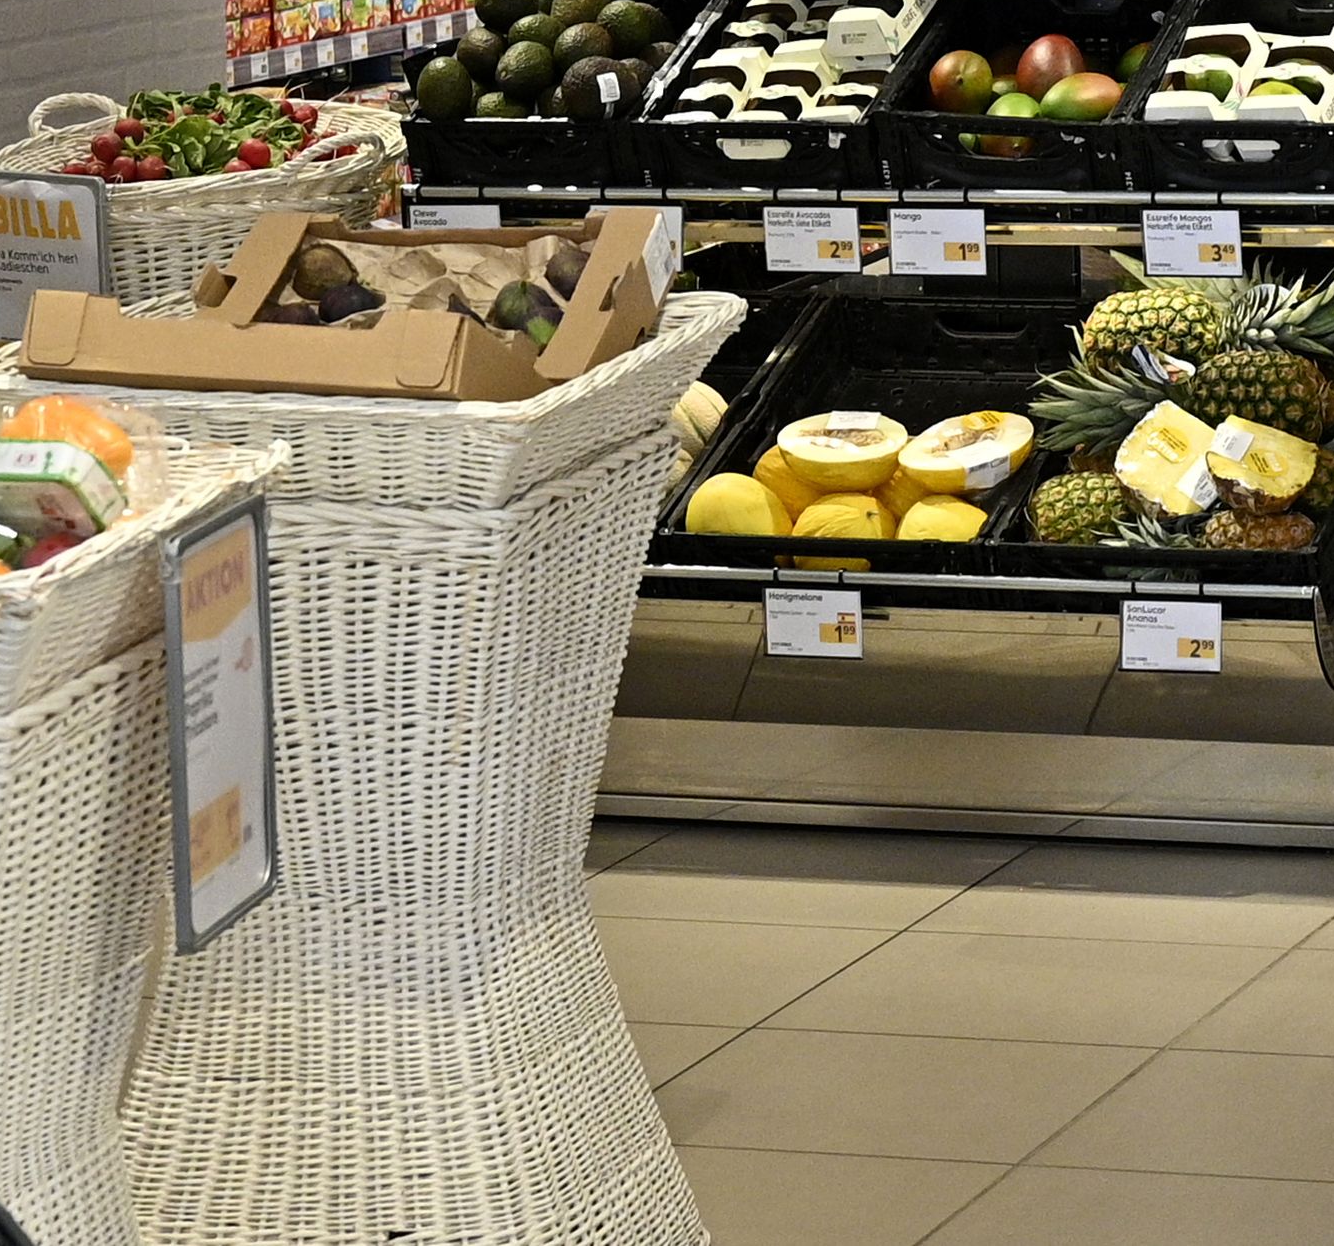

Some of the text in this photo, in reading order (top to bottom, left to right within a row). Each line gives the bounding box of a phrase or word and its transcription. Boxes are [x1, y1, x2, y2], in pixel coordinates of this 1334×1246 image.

[413, 209, 437, 219] Clever
[796, 210, 831, 219] Avocados
[894, 212, 922, 222] Mango
[413, 218, 448, 227] Avocado
[1147, 214, 1212, 224] Essreife Mangos
[769, 593, 823, 603] Honigmelone
[1127, 605, 1166, 614] SanLucar
[1127, 615, 1158, 623] Ananas
